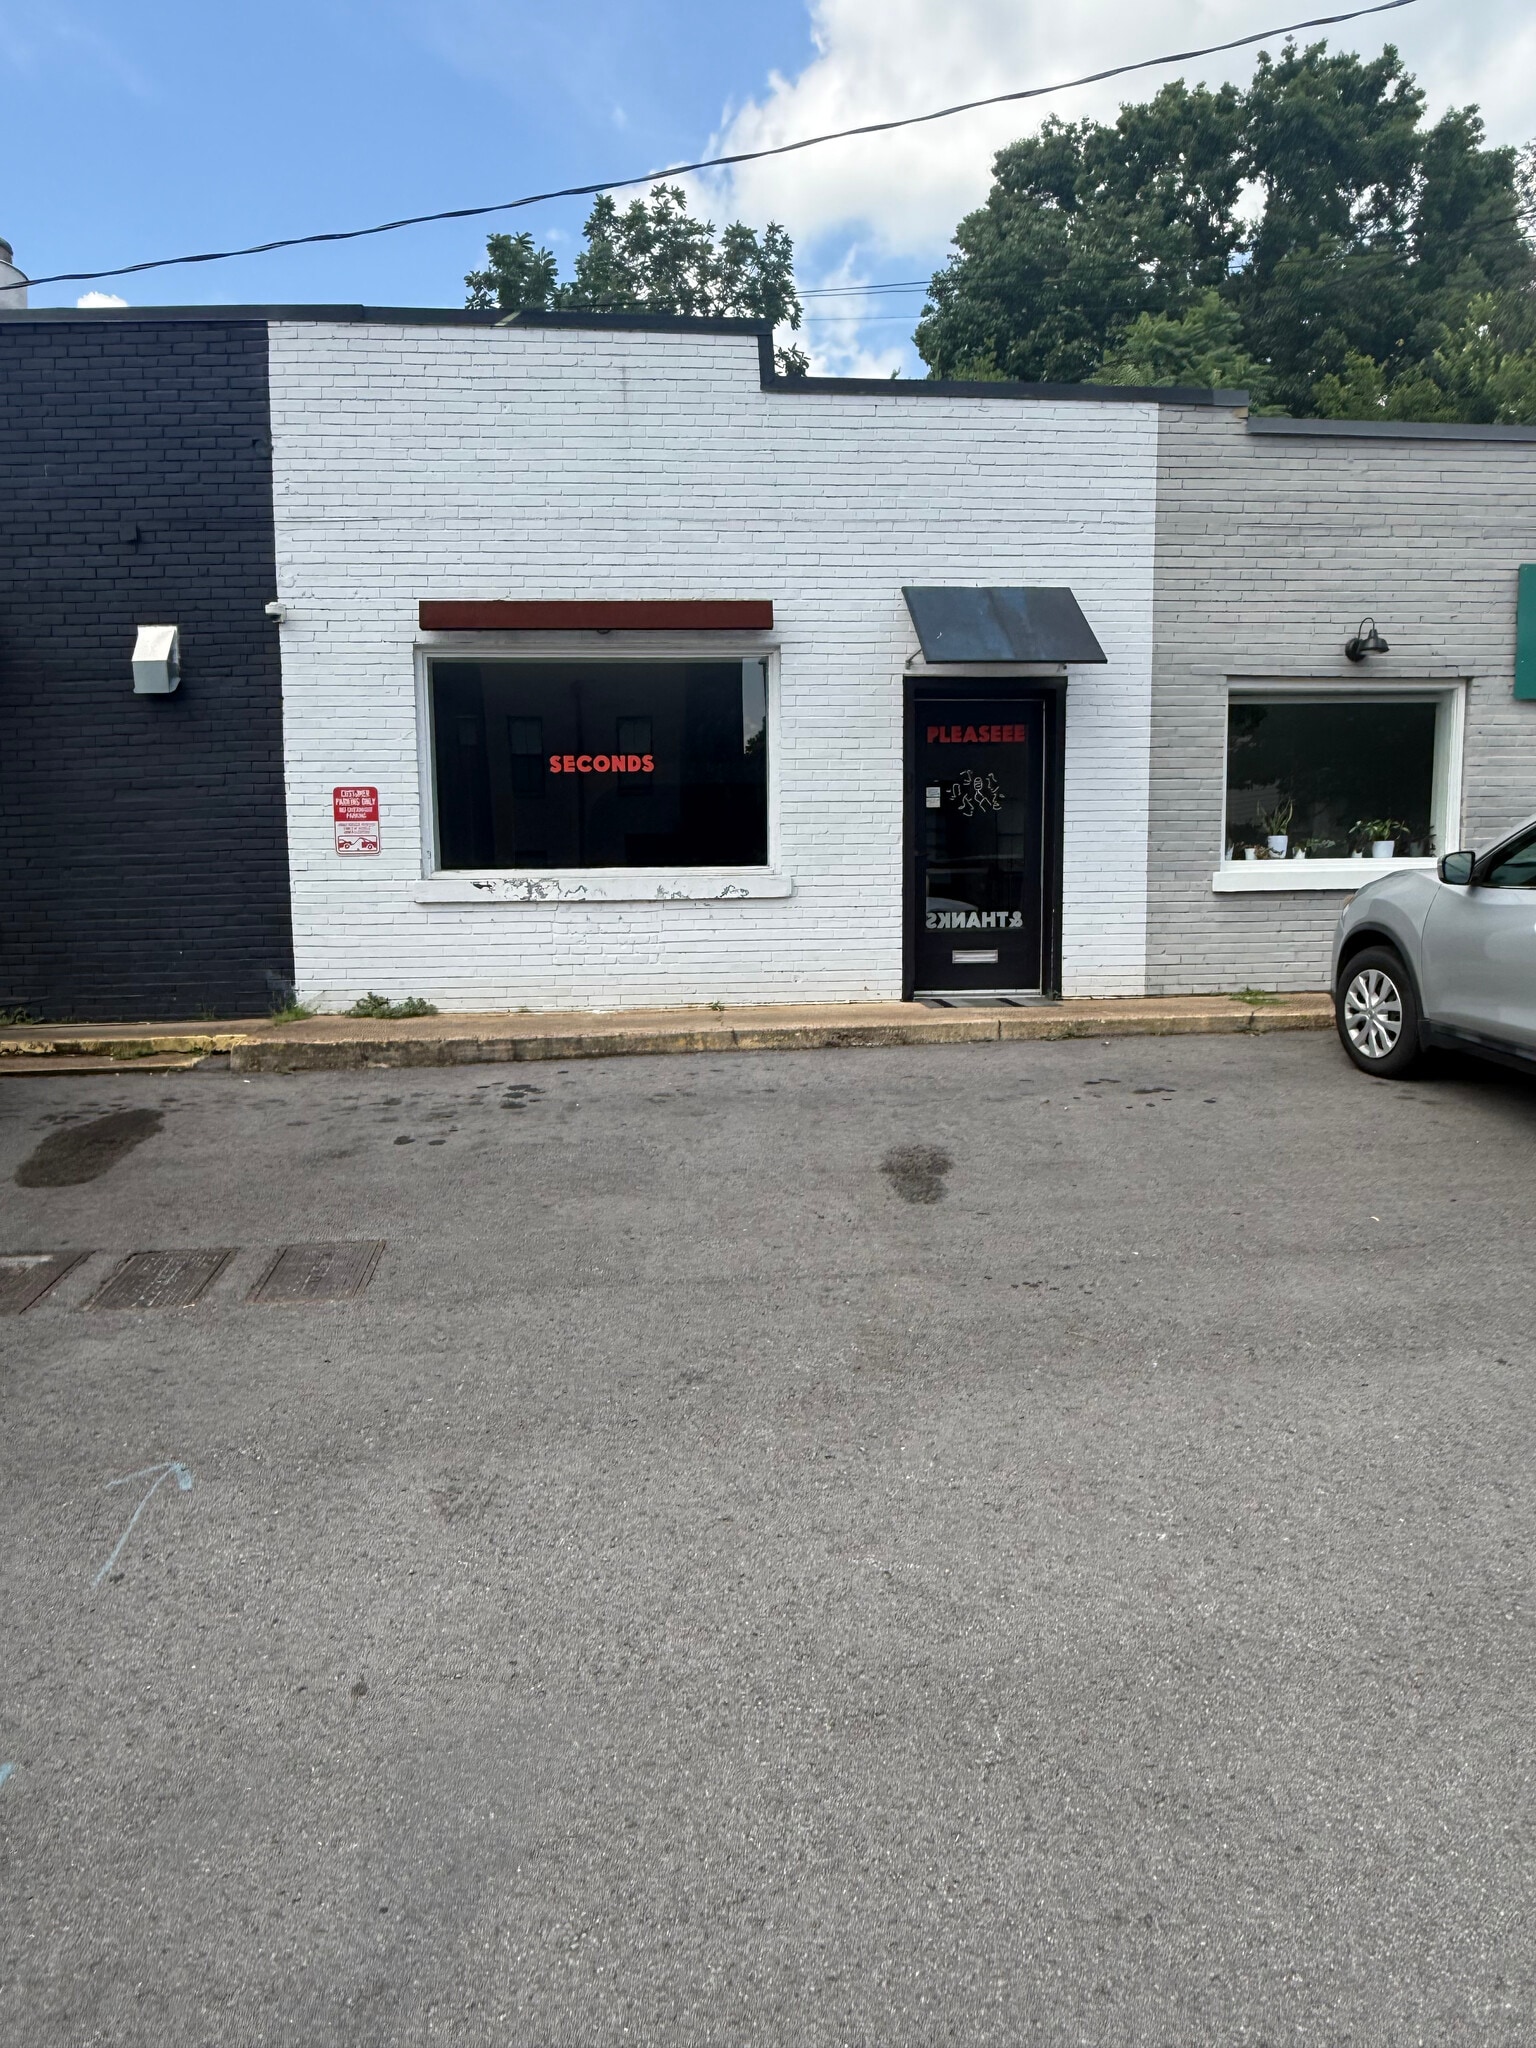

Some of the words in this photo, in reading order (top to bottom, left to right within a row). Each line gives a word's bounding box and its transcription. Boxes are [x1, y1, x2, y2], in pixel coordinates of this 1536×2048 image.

[927, 725, 1025, 743] PLEASEEE
[550, 755, 654, 773] SECONDS
[336, 798, 359, 806] PARKING
